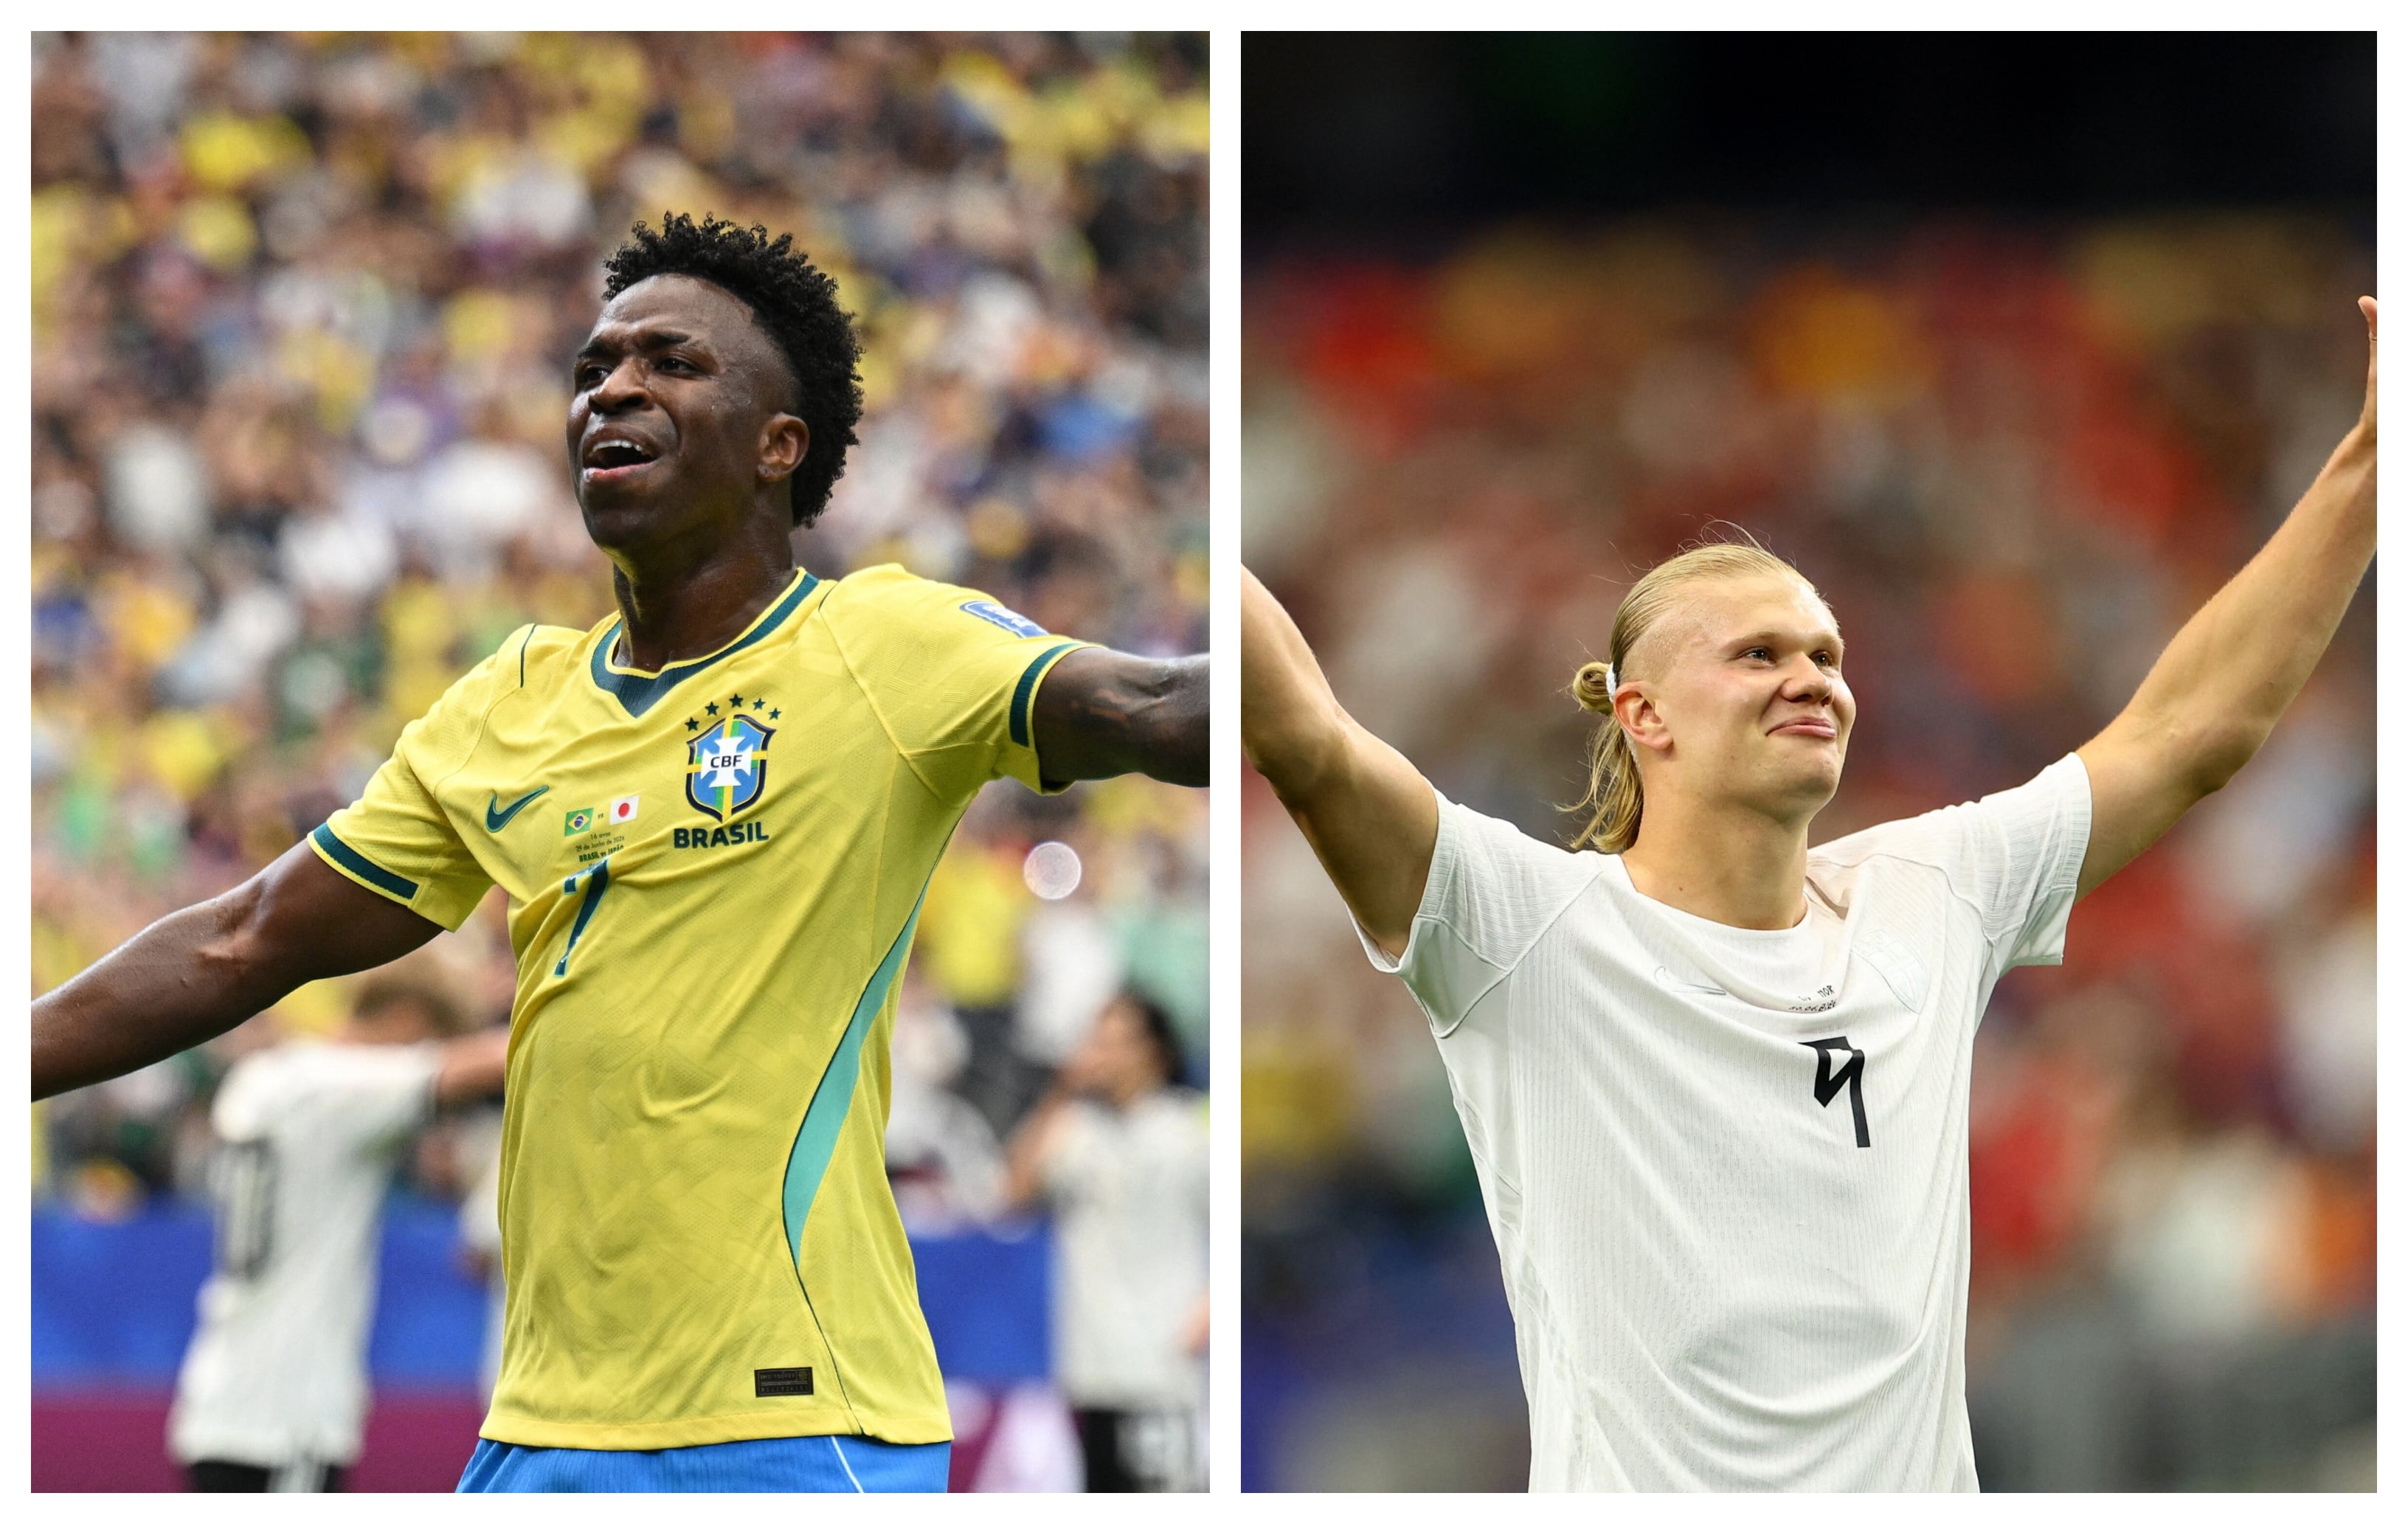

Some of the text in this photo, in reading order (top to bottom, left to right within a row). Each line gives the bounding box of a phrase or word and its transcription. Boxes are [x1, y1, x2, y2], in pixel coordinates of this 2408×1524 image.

[710, 755, 743, 768] CBF
[674, 822, 769, 848] BRASIL
[579, 851, 599, 862] BRASIL
[553, 857, 609, 977] 7
[1798, 1036, 1870, 1148] 9
